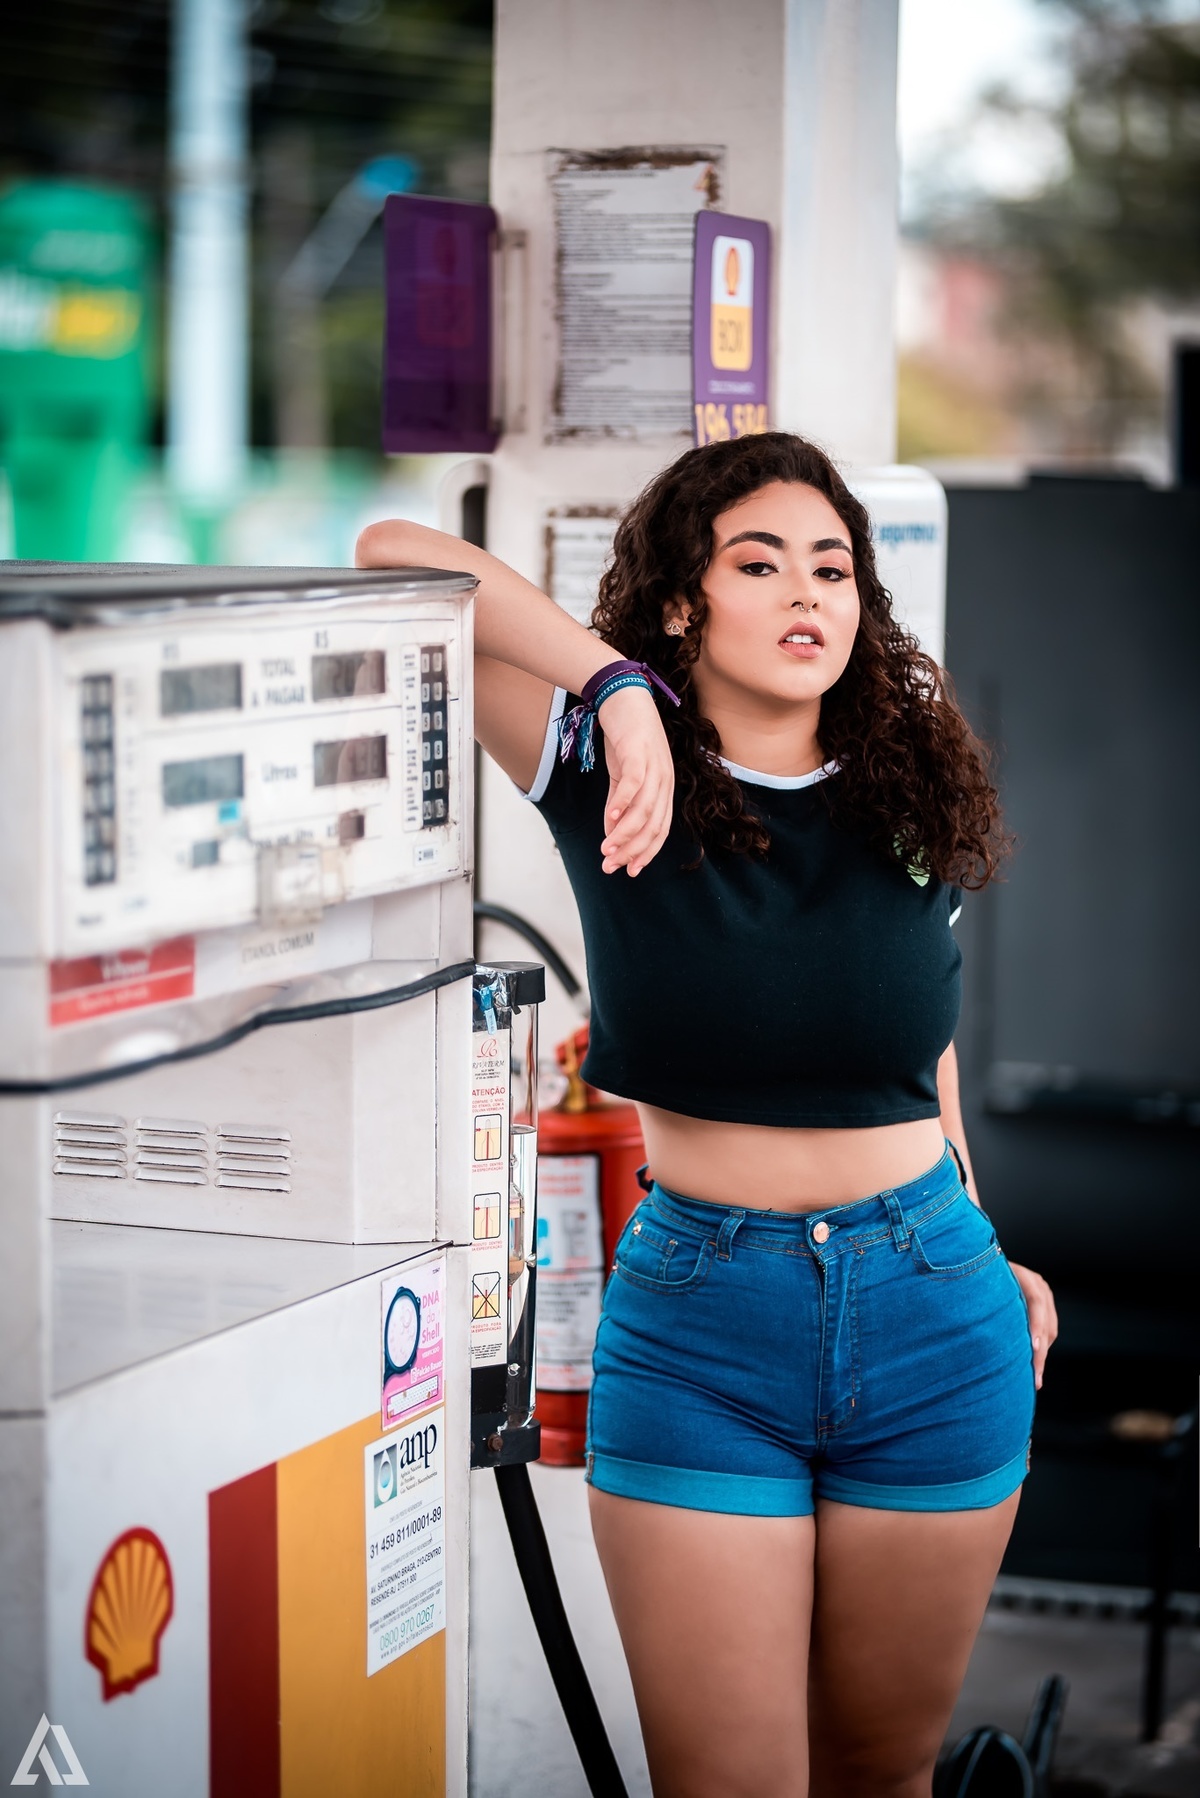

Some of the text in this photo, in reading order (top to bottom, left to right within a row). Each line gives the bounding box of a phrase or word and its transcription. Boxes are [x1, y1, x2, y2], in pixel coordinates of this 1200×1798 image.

[261, 659, 296, 679] TOTAL
[472, 1086, 506, 1096] ATENÇÃO
[422, 1290, 440, 1308] DNA
[422, 1322, 440, 1344] Shell
[400, 1424, 438, 1470] anp
[370, 1542, 378, 1559] 31
[381, 1533, 395, 1552] 459
[396, 1506, 442, 1543] 811/0001-89
[380, 1626, 398, 1651] 0800
[400, 1616, 415, 1638] 970
[416, 1604, 435, 1628] 0267
